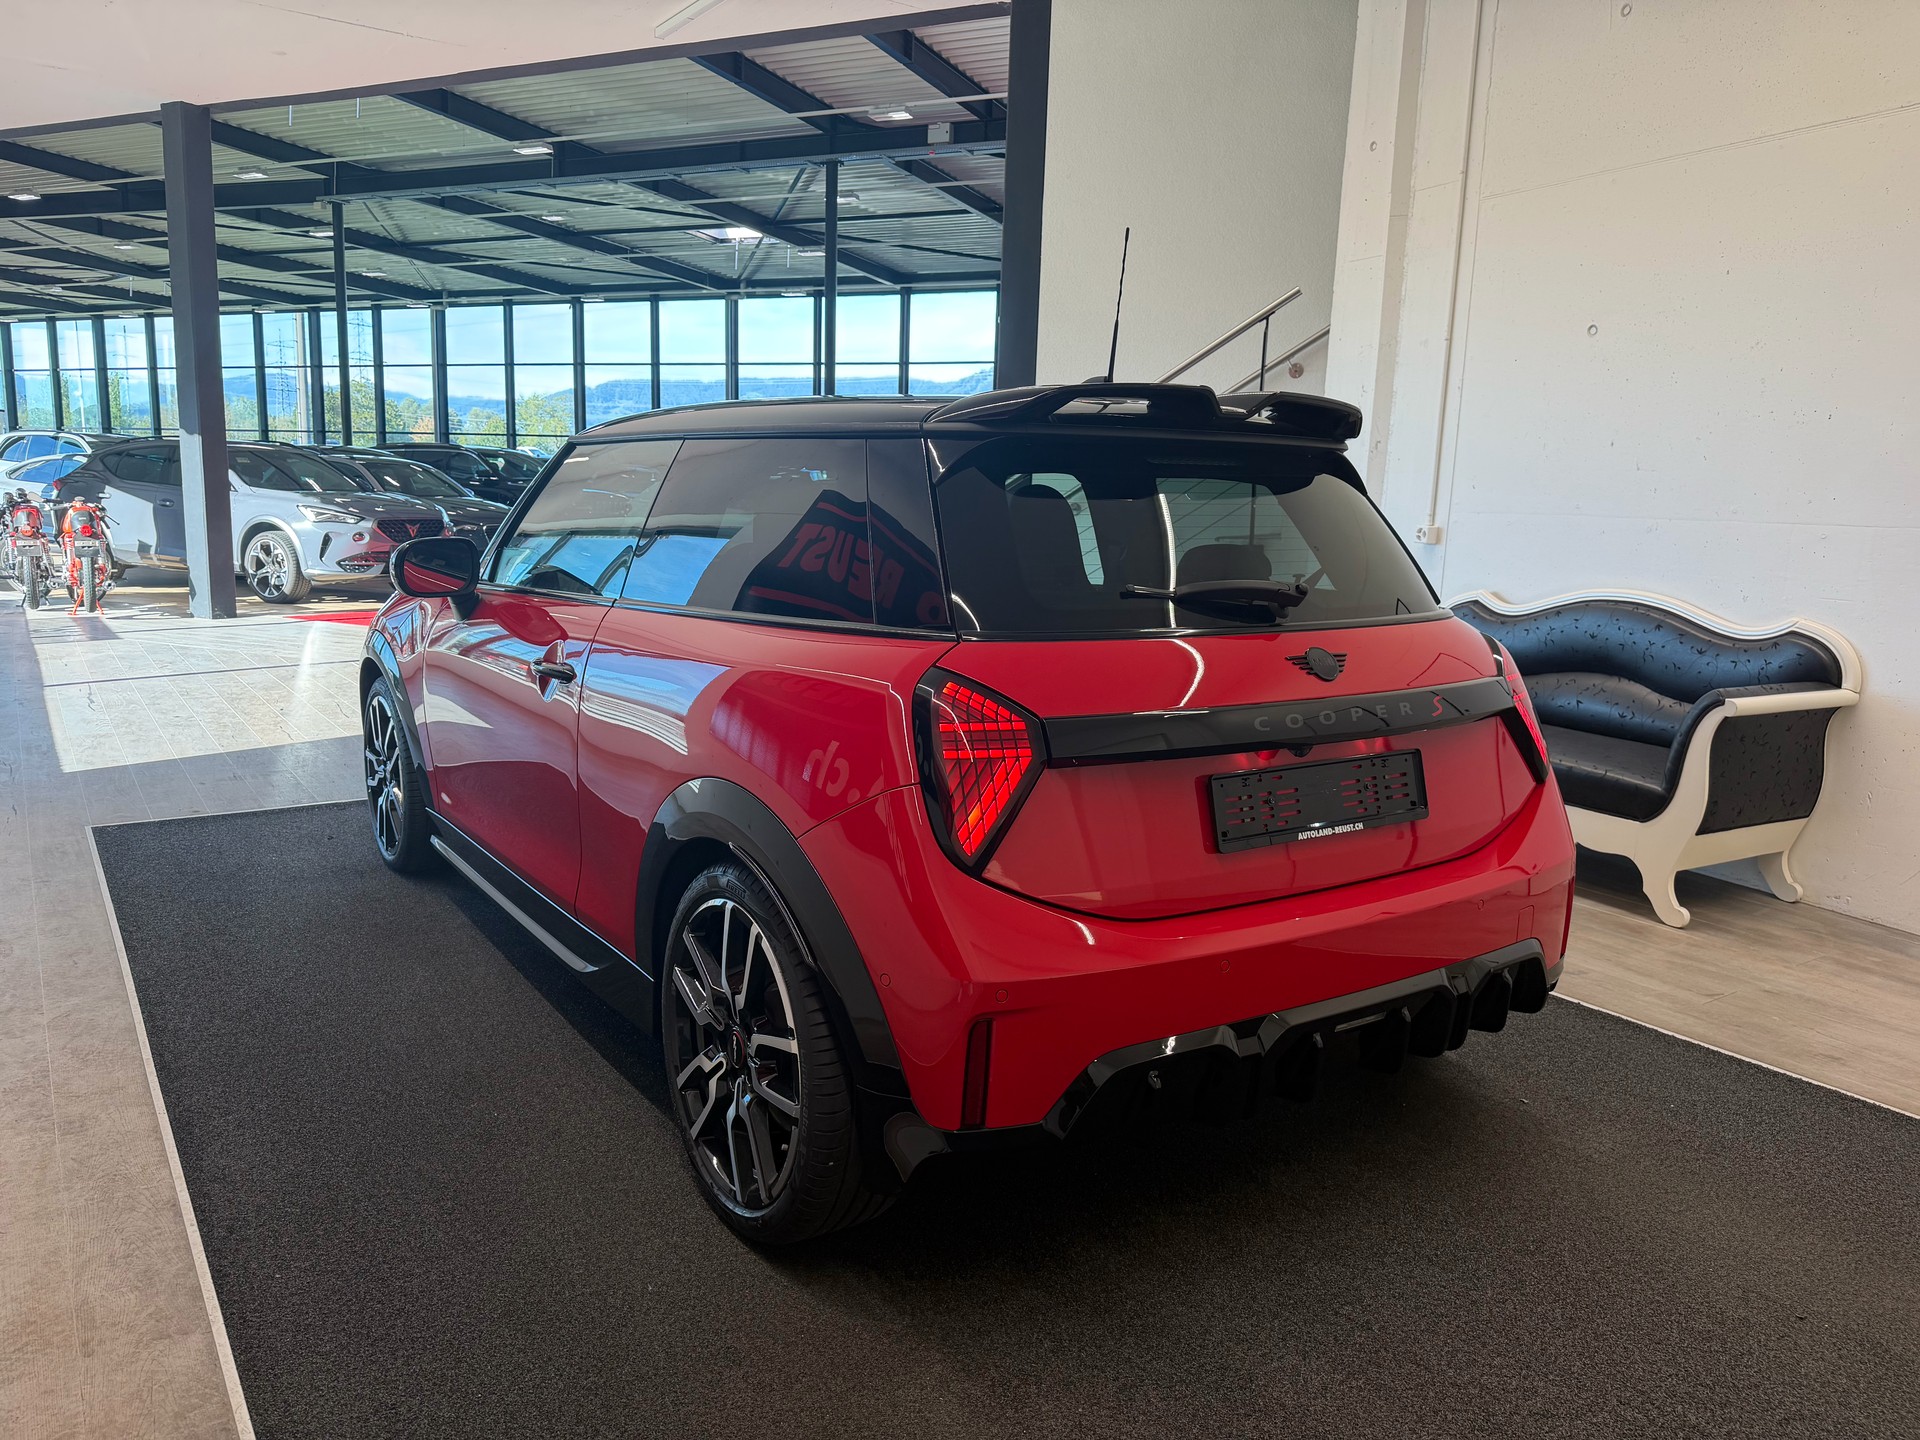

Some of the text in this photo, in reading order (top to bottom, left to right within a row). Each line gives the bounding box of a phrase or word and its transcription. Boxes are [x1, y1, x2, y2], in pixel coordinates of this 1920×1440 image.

[1254, 695, 1443, 732] COOPER S
[1298, 822, 1364, 841] AUTOLAND-REUST.CH
